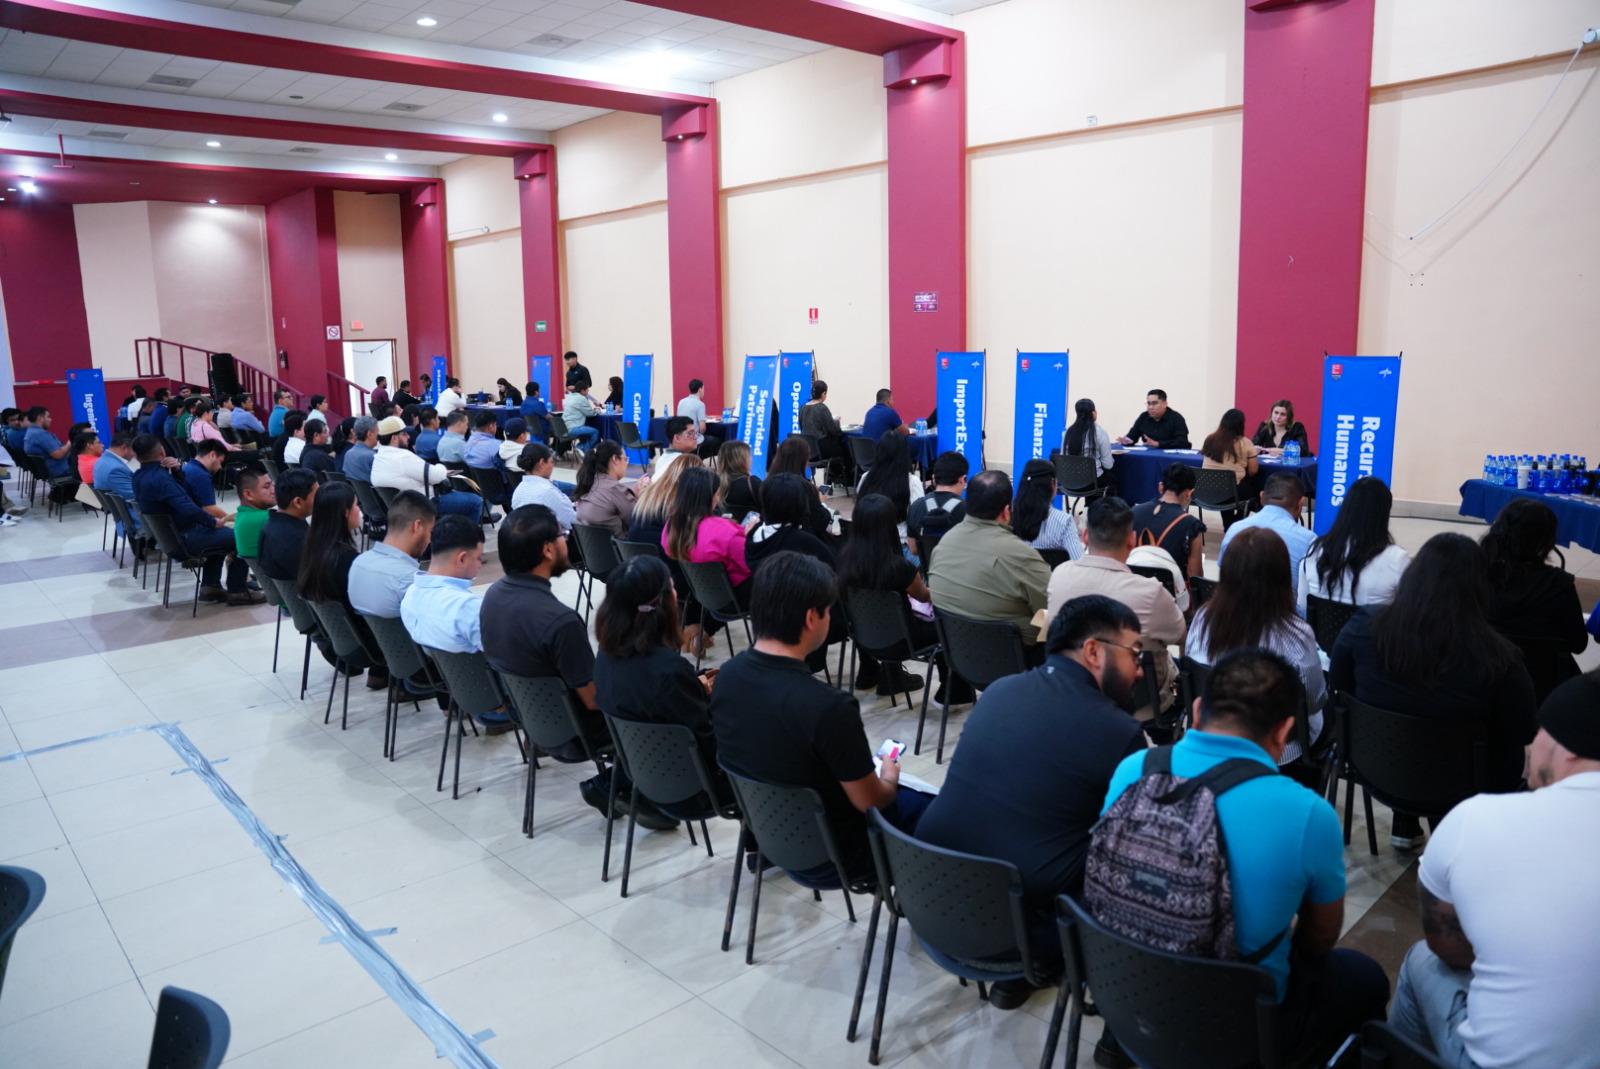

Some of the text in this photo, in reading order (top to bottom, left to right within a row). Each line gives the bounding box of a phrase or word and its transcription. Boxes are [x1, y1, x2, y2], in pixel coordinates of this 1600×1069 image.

[633, 393, 641, 427] Calid
[743, 385, 758, 447] Patrimon
[753, 389, 768, 456] Seguridad
[791, 381, 801, 434] Operaci
[953, 379, 968, 456] ImportEx
[1032, 403, 1047, 460] Finanz
[1331, 414, 1355, 507] Humanos
[1358, 416, 1381, 480] Recur
